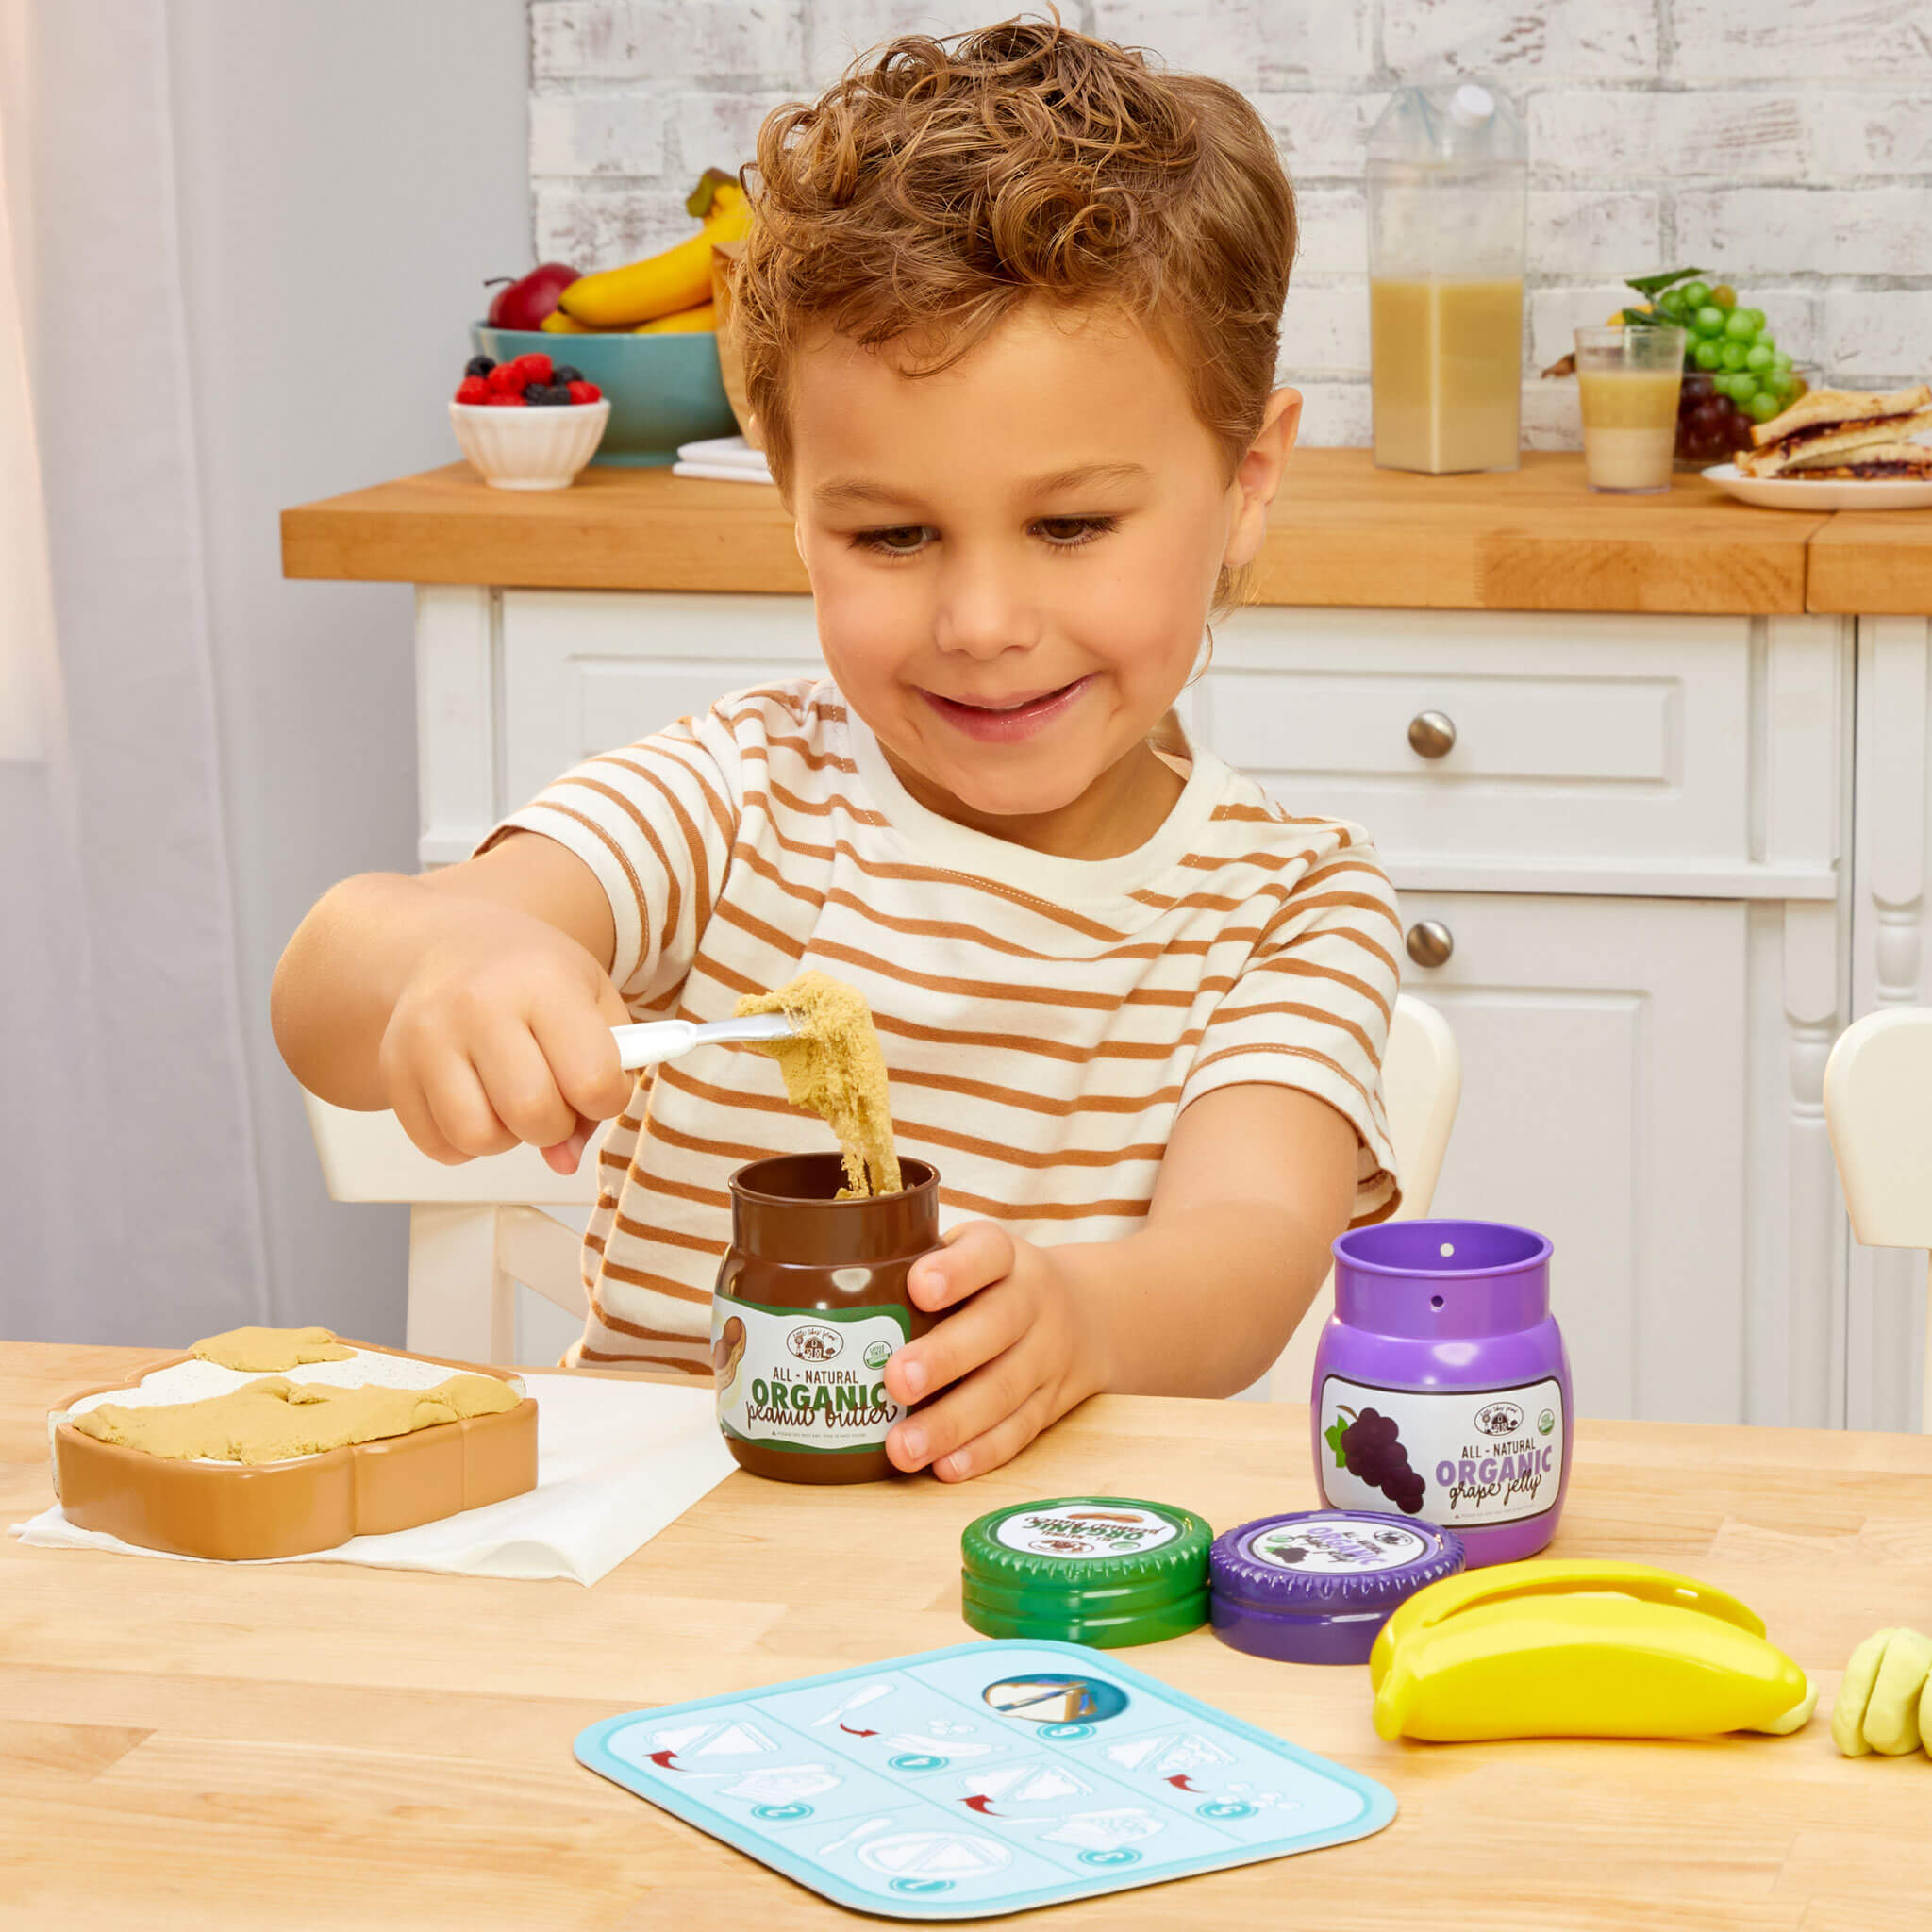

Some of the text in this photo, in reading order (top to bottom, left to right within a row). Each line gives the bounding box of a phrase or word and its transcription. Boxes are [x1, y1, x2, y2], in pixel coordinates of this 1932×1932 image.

[773, 1366, 792, 1382] ALL
[805, 1370, 859, 1385] NATURAL
[752, 1378, 887, 1412] ORGANIC
[745, 1400, 898, 1430] peanut butter
[1461, 1445, 1482, 1459] ALL
[1493, 1438, 1536, 1457] NATURAL
[1436, 1445, 1552, 1487] ORGANIC
[1449, 1468, 1541, 1509] grape jelly
